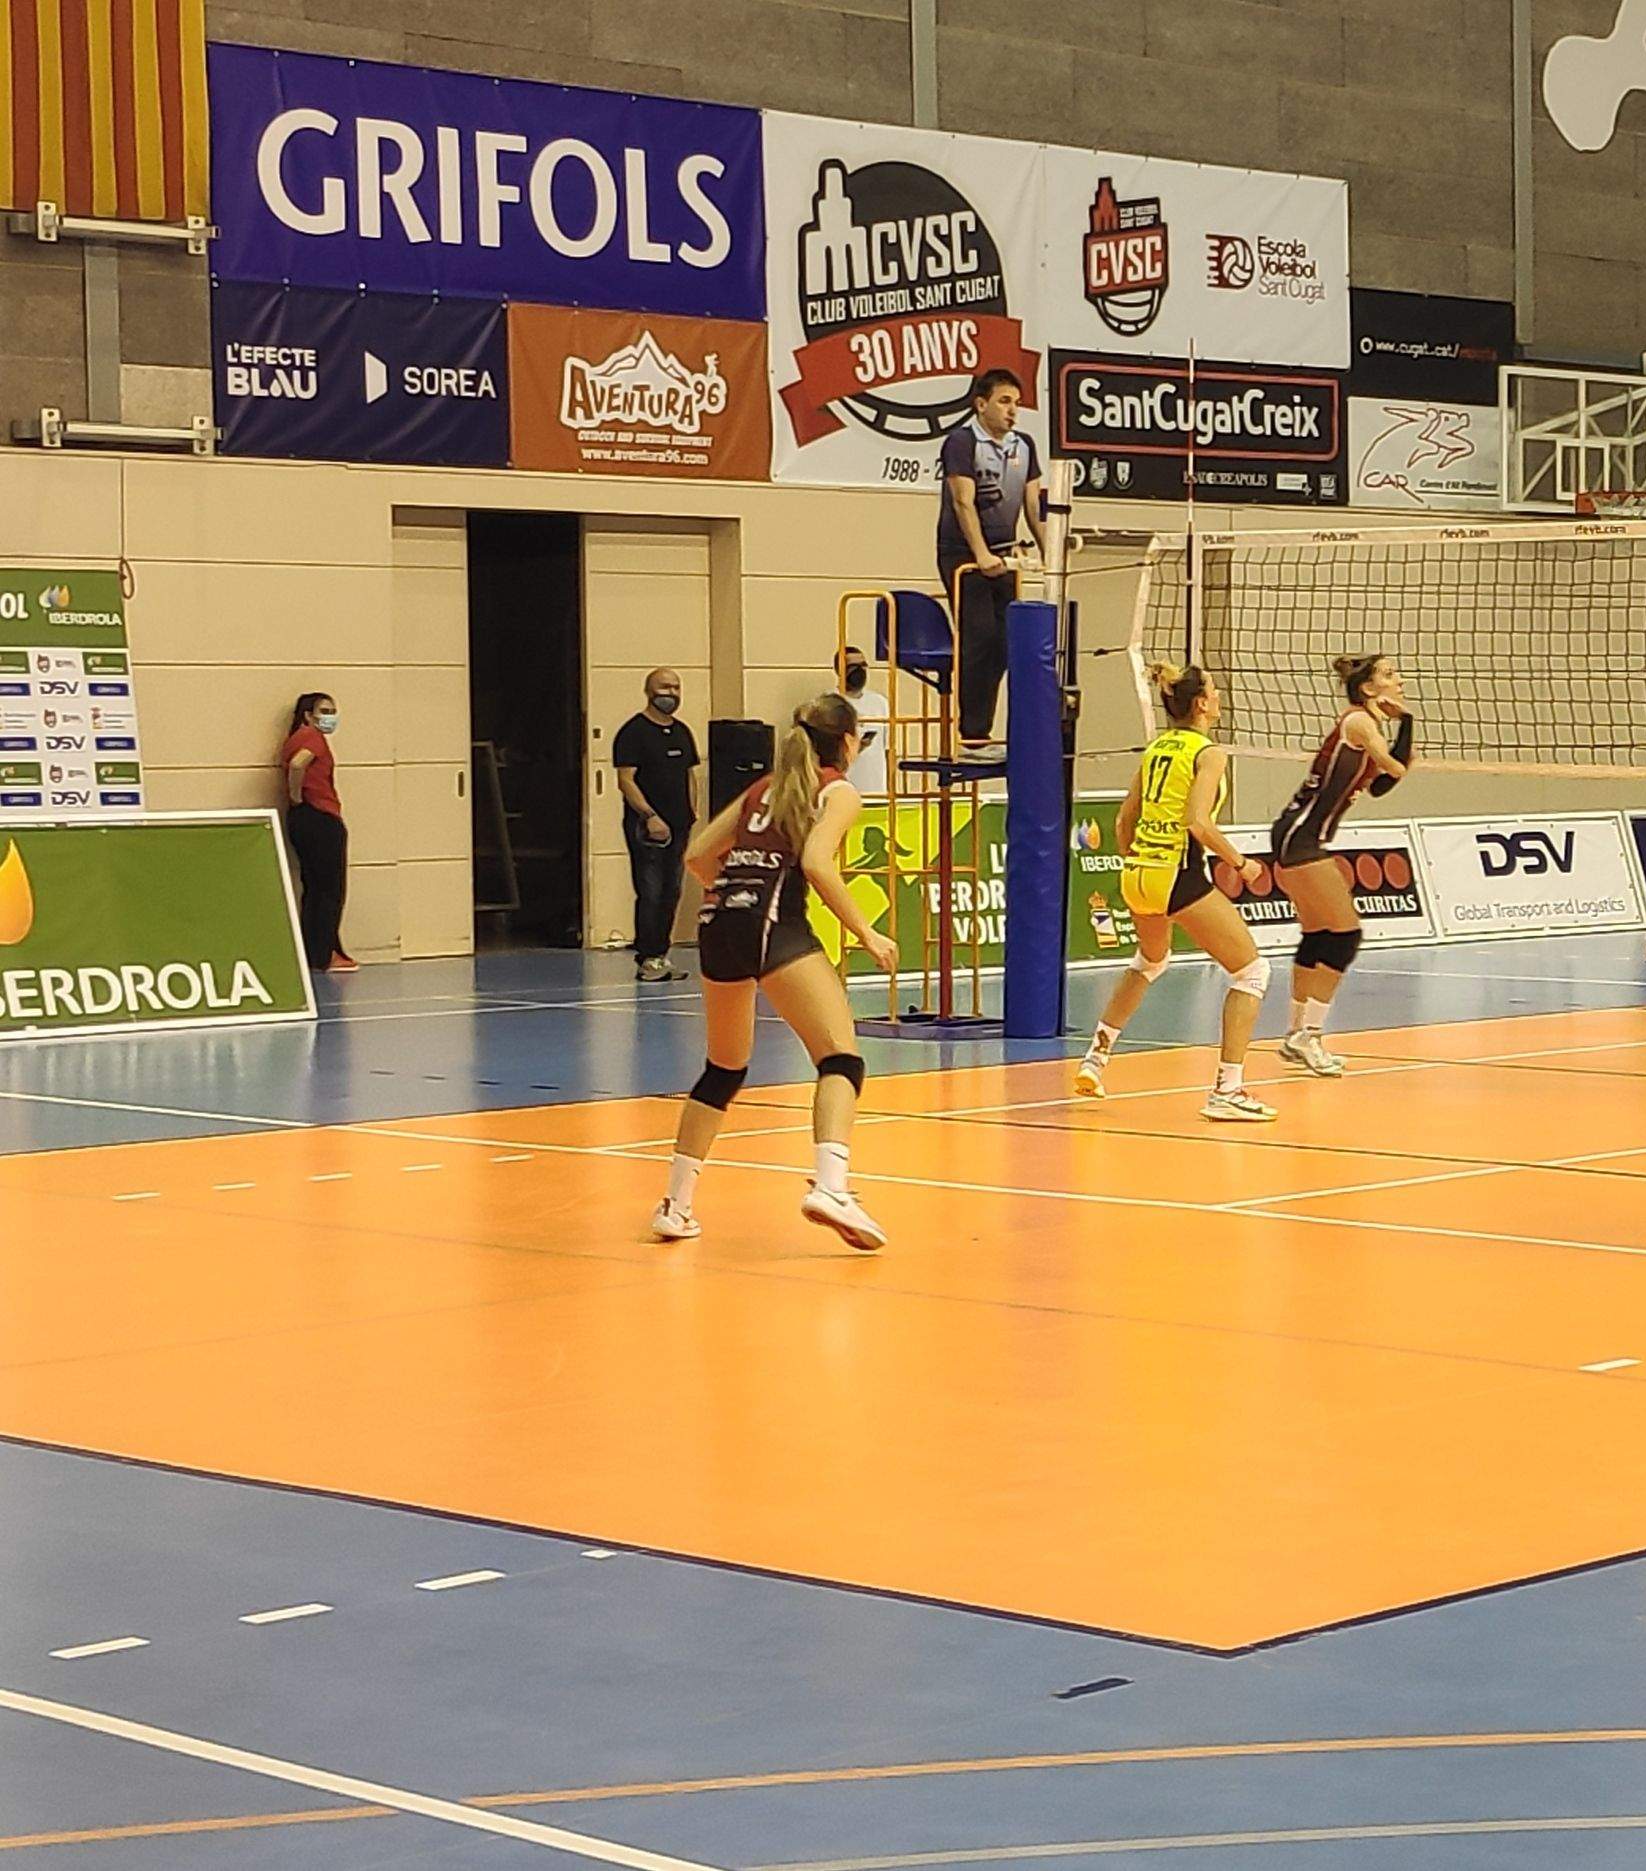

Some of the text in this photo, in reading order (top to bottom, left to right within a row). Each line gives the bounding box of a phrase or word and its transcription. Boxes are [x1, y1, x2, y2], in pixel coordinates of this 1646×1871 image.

[257, 109, 731, 268] GRIFOLS
[872, 211, 978, 285] CVSC
[1257, 236, 1306, 258] Escola
[1090, 235, 1163, 287] CVSC
[1258, 256, 1316, 279] Voleibol
[807, 274, 1001, 326] CLUB VOLEIBOL SANT CUGAT
[1258, 277, 1326, 304] Sant Cugat
[226, 343, 317, 367] L'EFECTE
[852, 320, 979, 384] 30 ANYS
[227, 367, 318, 400] BLAU
[403, 366, 497, 398] SOREA
[1078, 377, 1320, 446] SantCugatCreix
[881, 456, 919, 483] 1988
[1363, 471, 1424, 503] CAR
[49, 612, 122, 626] IBERDROLA
[39, 681, 78, 695] DSV
[45, 736, 85, 750] DSV
[1145, 755, 1174, 804] 17
[51, 790, 91, 805] DSV
[1081, 855, 1124, 872] IBERD
[1475, 831, 1575, 877] DSV
[1235, 899, 1298, 921] CURITA
[1353, 894, 1418, 914] CURITAS
[1454, 897, 1626, 922] Global Transport and Logistics
[0, 960, 273, 1020] ERDROLA
